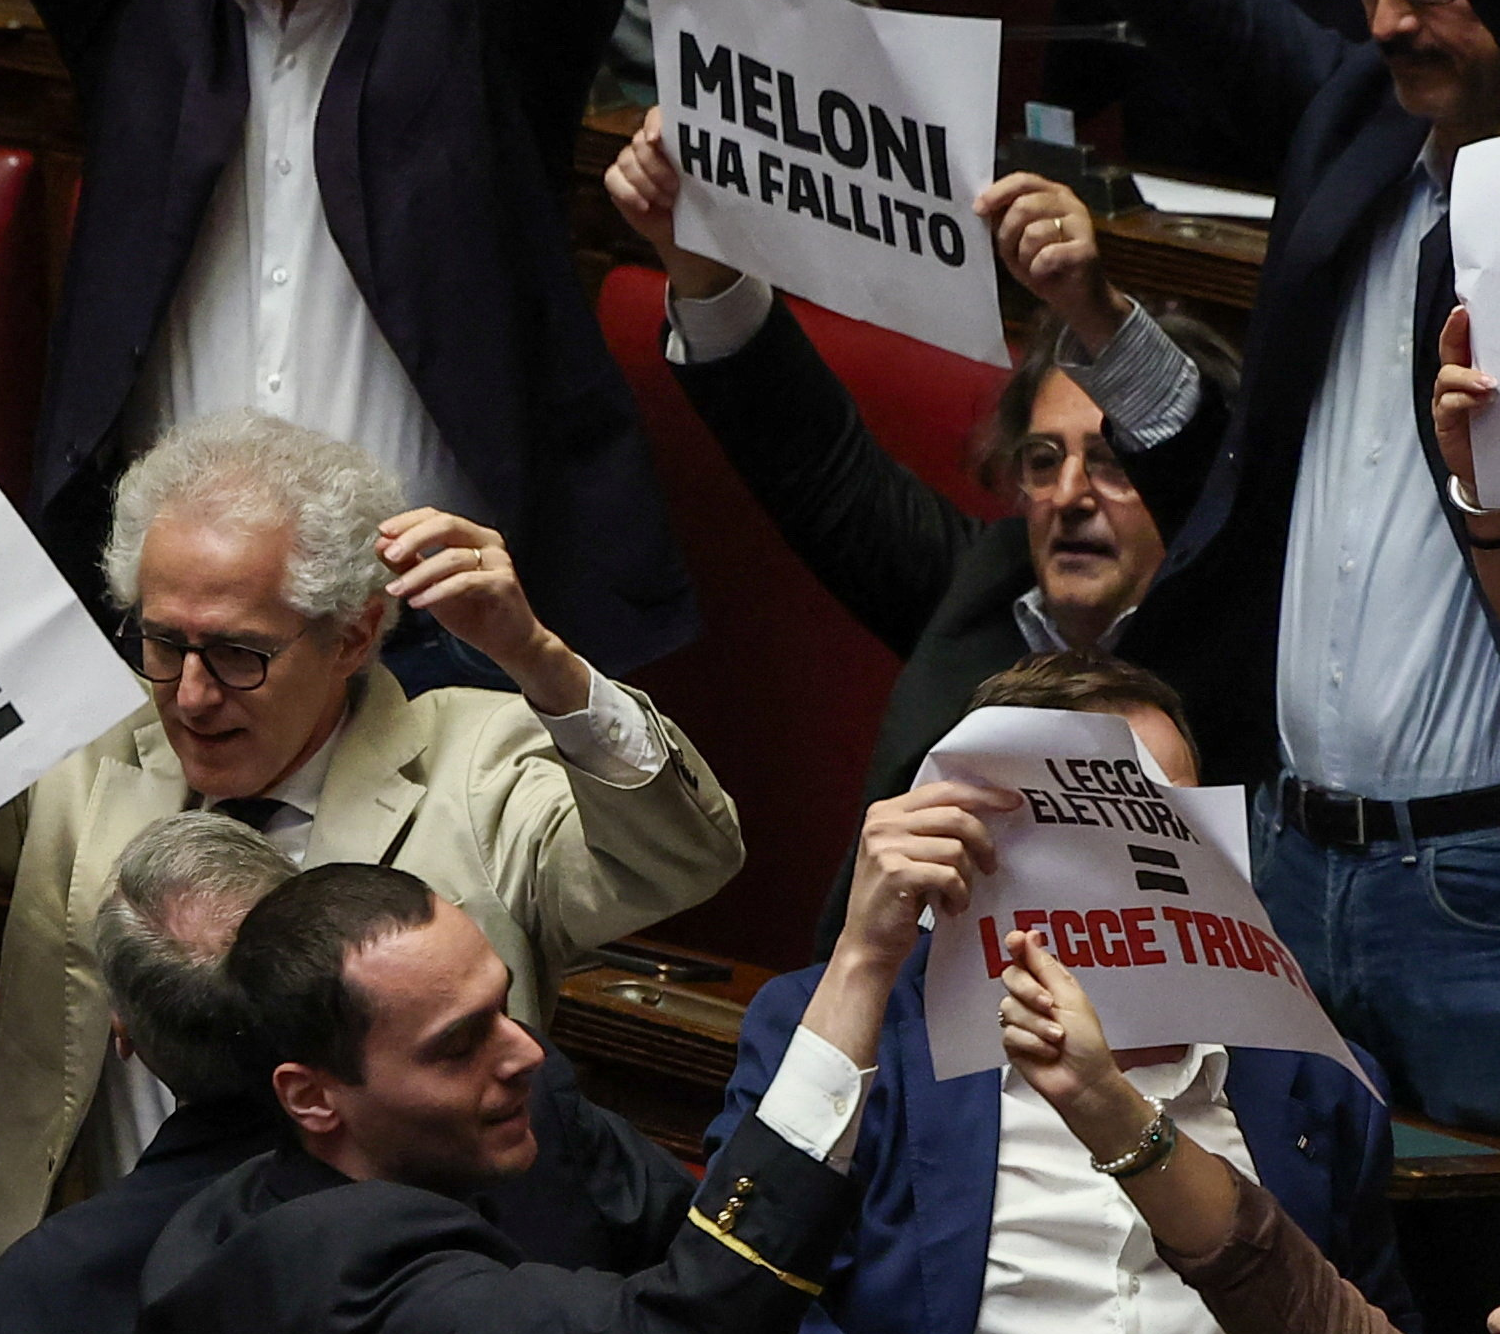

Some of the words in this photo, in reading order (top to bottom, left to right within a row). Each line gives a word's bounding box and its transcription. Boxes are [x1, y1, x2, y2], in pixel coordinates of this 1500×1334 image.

[679, 31, 953, 202] MELONI
[676, 122, 748, 196] HA
[759, 156, 965, 268] FALLITO
[1019, 787, 1201, 845] ELETTORA
